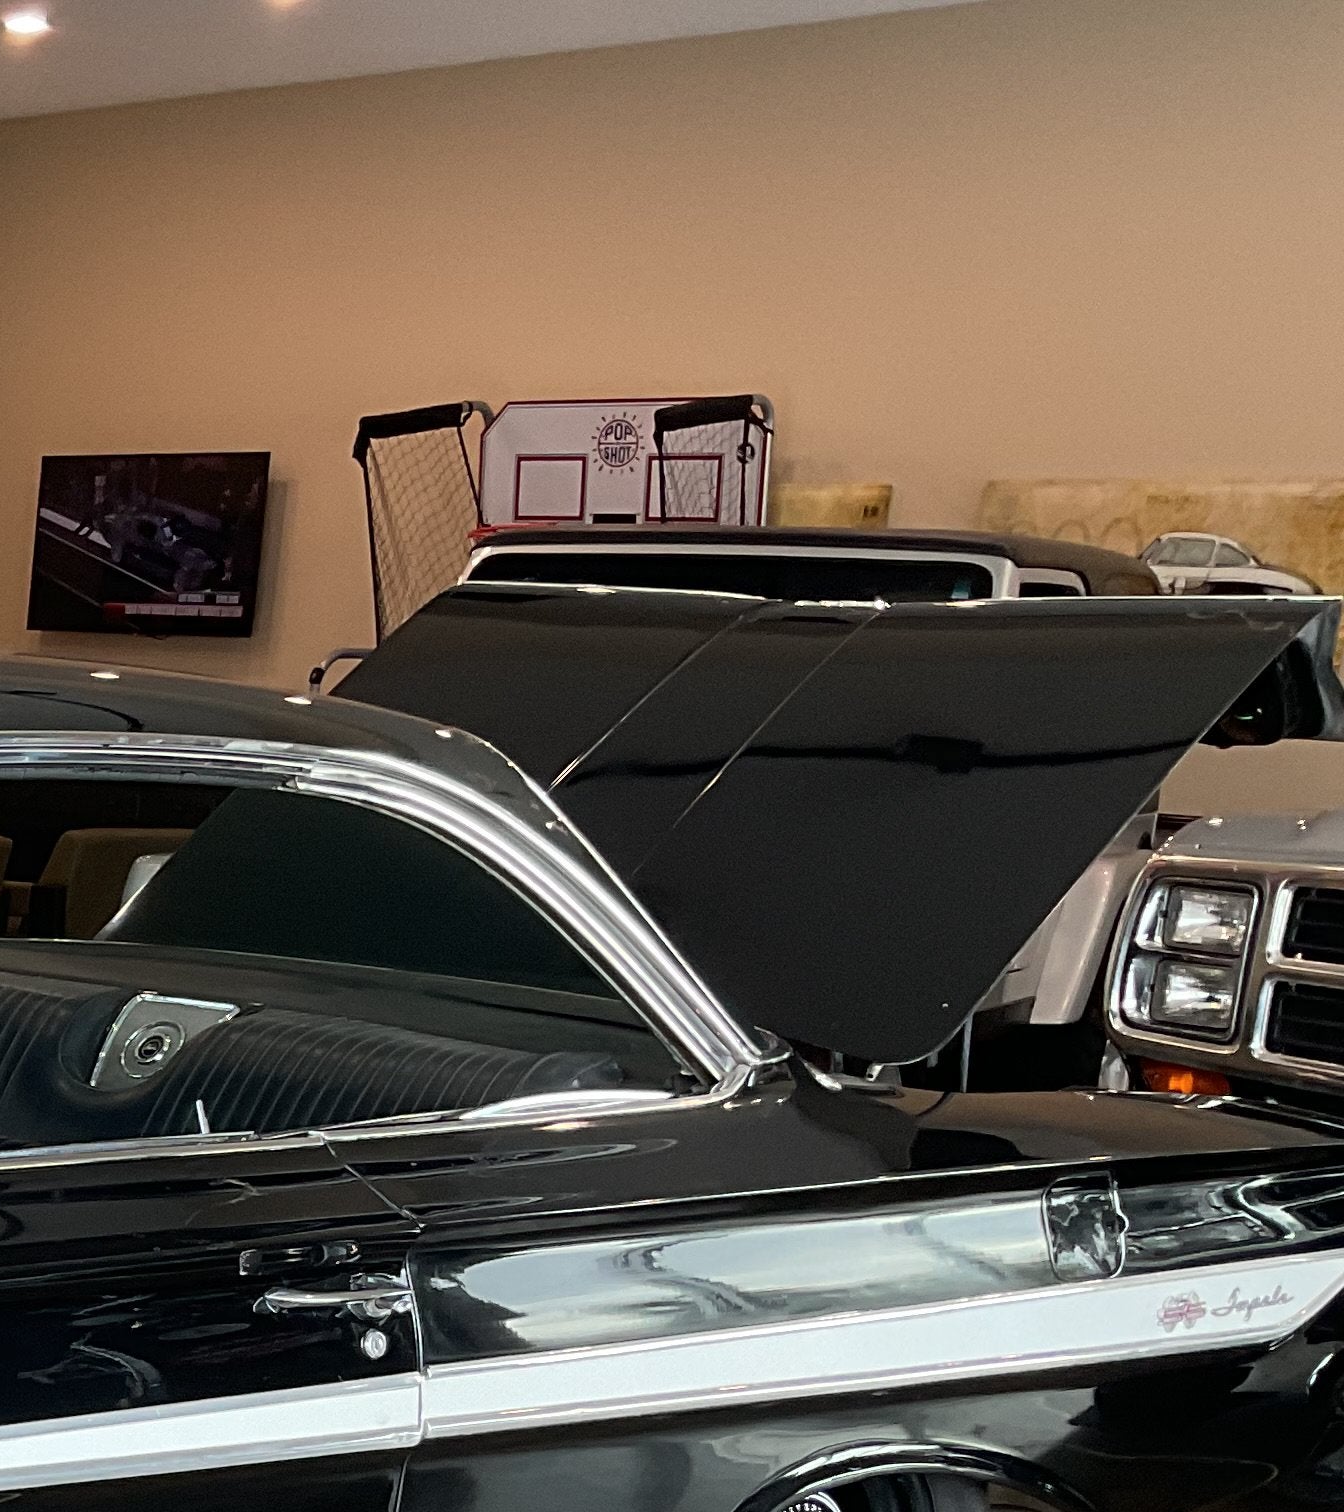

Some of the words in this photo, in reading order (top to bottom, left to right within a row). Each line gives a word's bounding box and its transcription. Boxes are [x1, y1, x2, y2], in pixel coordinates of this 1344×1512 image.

[605, 423, 633, 441] POP
[604, 446, 631, 463] SHOT
[1210, 1285, 1294, 1321] Impala
